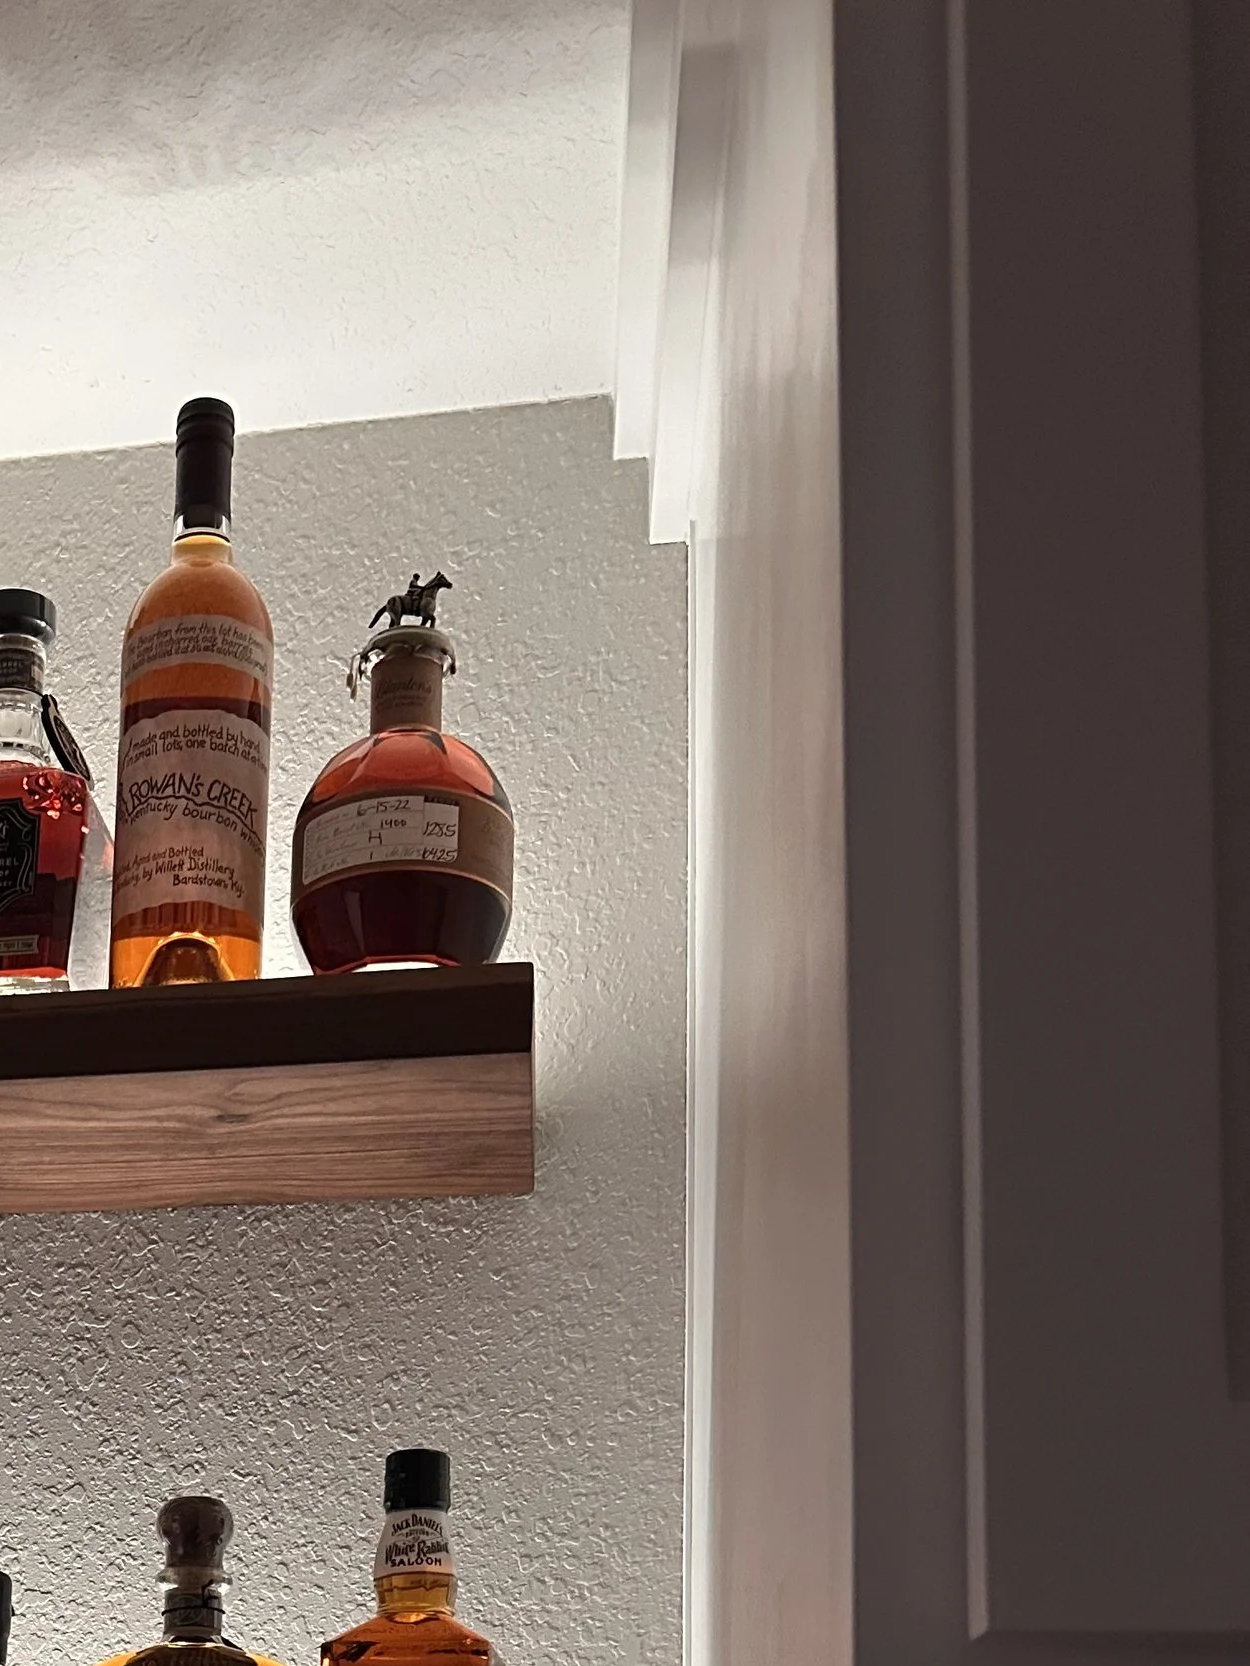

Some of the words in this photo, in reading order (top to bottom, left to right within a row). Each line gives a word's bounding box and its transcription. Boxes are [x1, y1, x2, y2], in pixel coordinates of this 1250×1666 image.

[175, 622, 197, 634] from
[200, 622, 217, 633] this
[132, 732, 157, 749] made
[159, 725, 180, 743] and
[183, 724, 223, 738] bottled
[227, 727, 238, 745] by
[135, 742, 157, 763] small
[186, 738, 206, 749] one
[210, 738, 239, 757] batch
[207, 779, 258, 829] CREEK
[356, 800, 411, 816] 6-15-22
[182, 803, 237, 833] bourbon
[380, 819, 407, 829] 1400
[368, 830, 383, 845] H
[168, 846, 204, 858] Bottled
[155, 860, 185, 875] Willett
[187, 857, 235, 879] Distillery
[392, 1519, 410, 1536] JACK
[385, 1542, 416, 1564] White
[390, 1557, 441, 1567] SALOON
